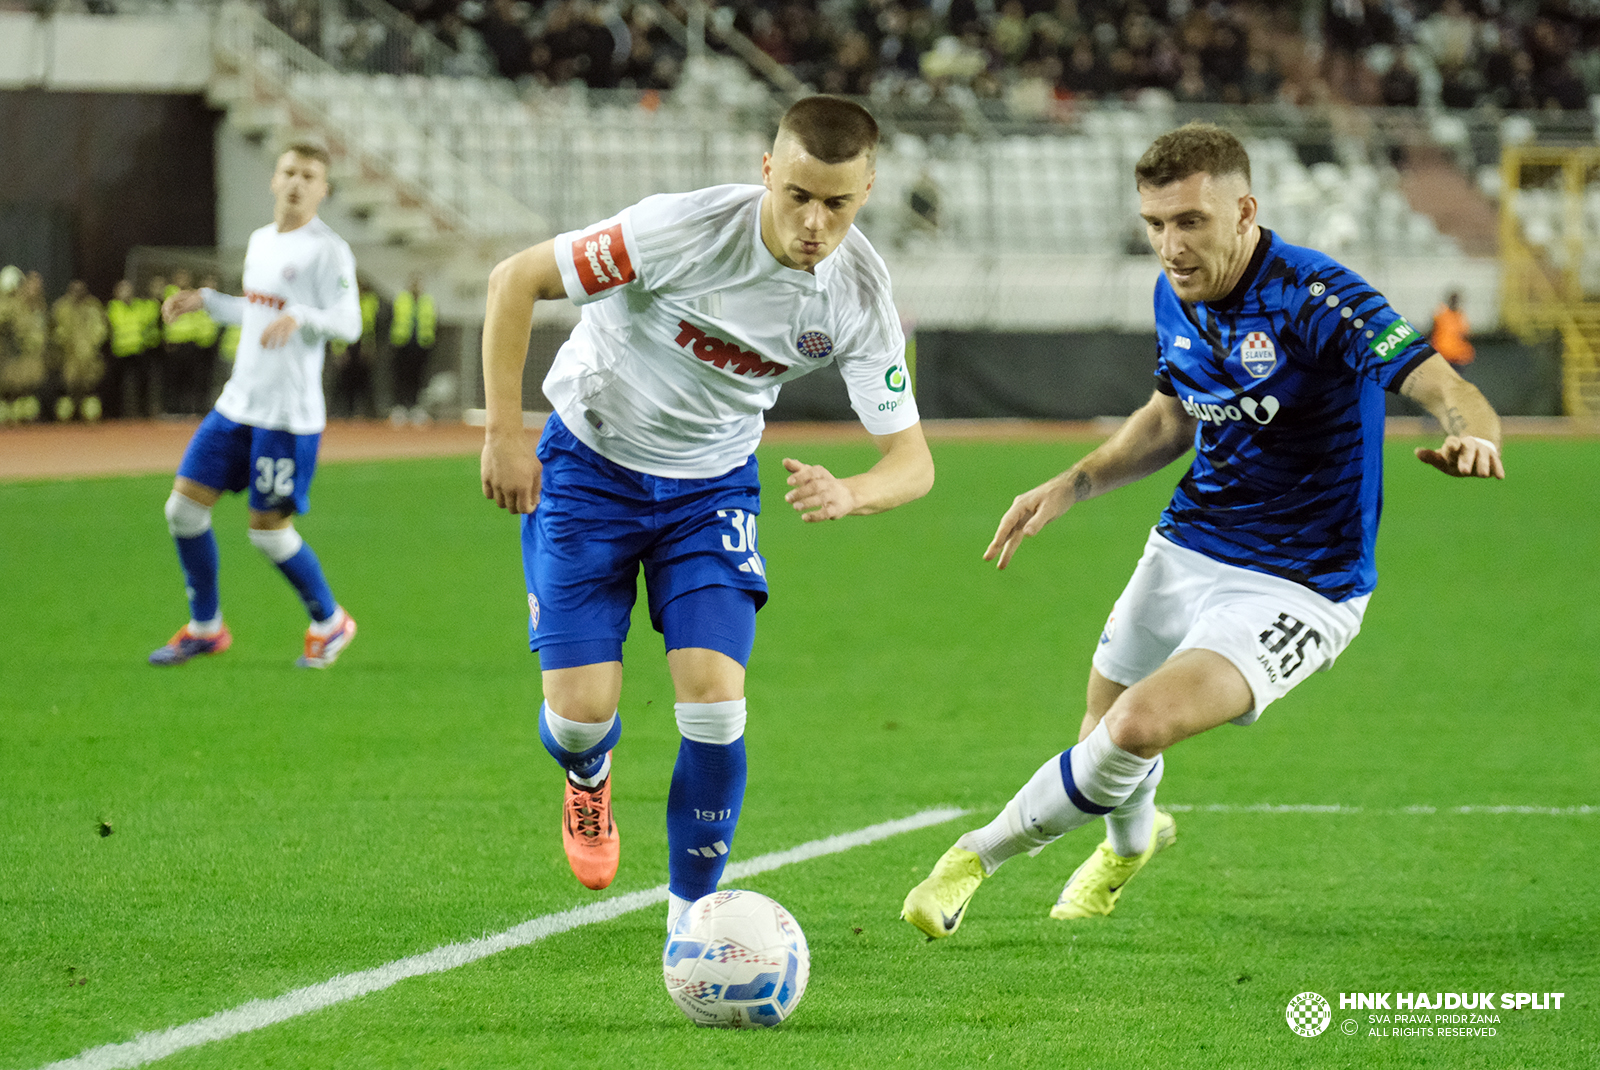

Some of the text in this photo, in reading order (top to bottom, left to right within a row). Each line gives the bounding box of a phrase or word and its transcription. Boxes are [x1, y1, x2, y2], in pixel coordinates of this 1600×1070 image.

[584, 240, 611, 284] Sport
[598, 233, 623, 281] Super
[674, 320, 789, 378] TOMMY
[1245, 350, 1274, 360] SLAVEN
[1180, 394, 1243, 426] elupo
[254, 456, 296, 497] 32
[1256, 654, 1278, 683] JAKO
[693, 808, 731, 822] 1911
